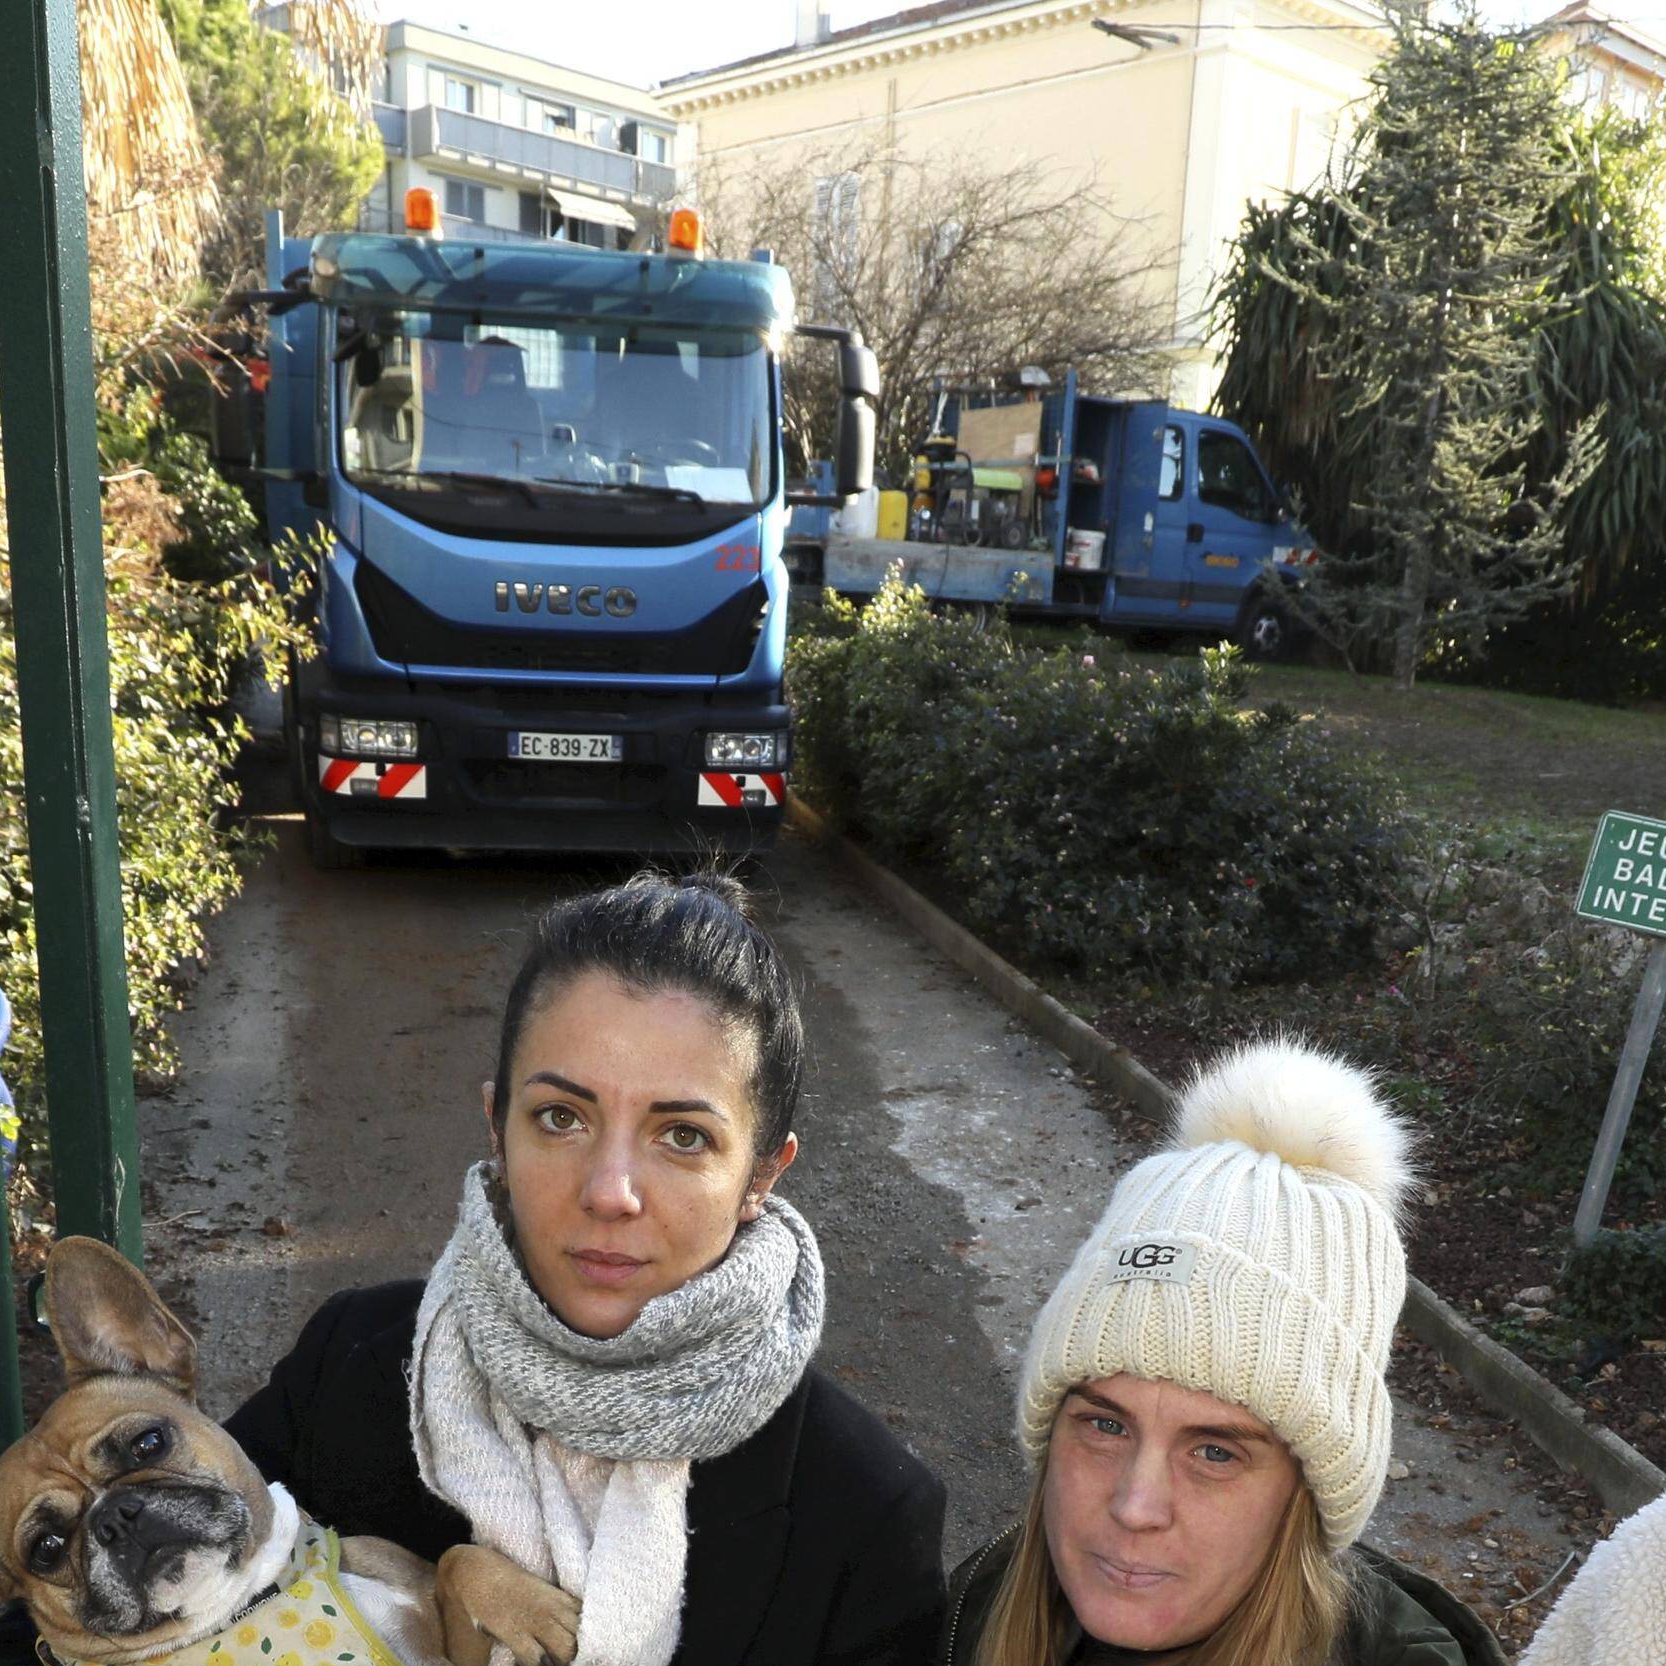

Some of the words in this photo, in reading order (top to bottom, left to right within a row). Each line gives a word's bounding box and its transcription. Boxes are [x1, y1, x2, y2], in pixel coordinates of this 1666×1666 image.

[495, 581, 637, 618] IVECO
[521, 736, 609, 758] EC-839-ZX
[1118, 1244, 1176, 1268] UGG
